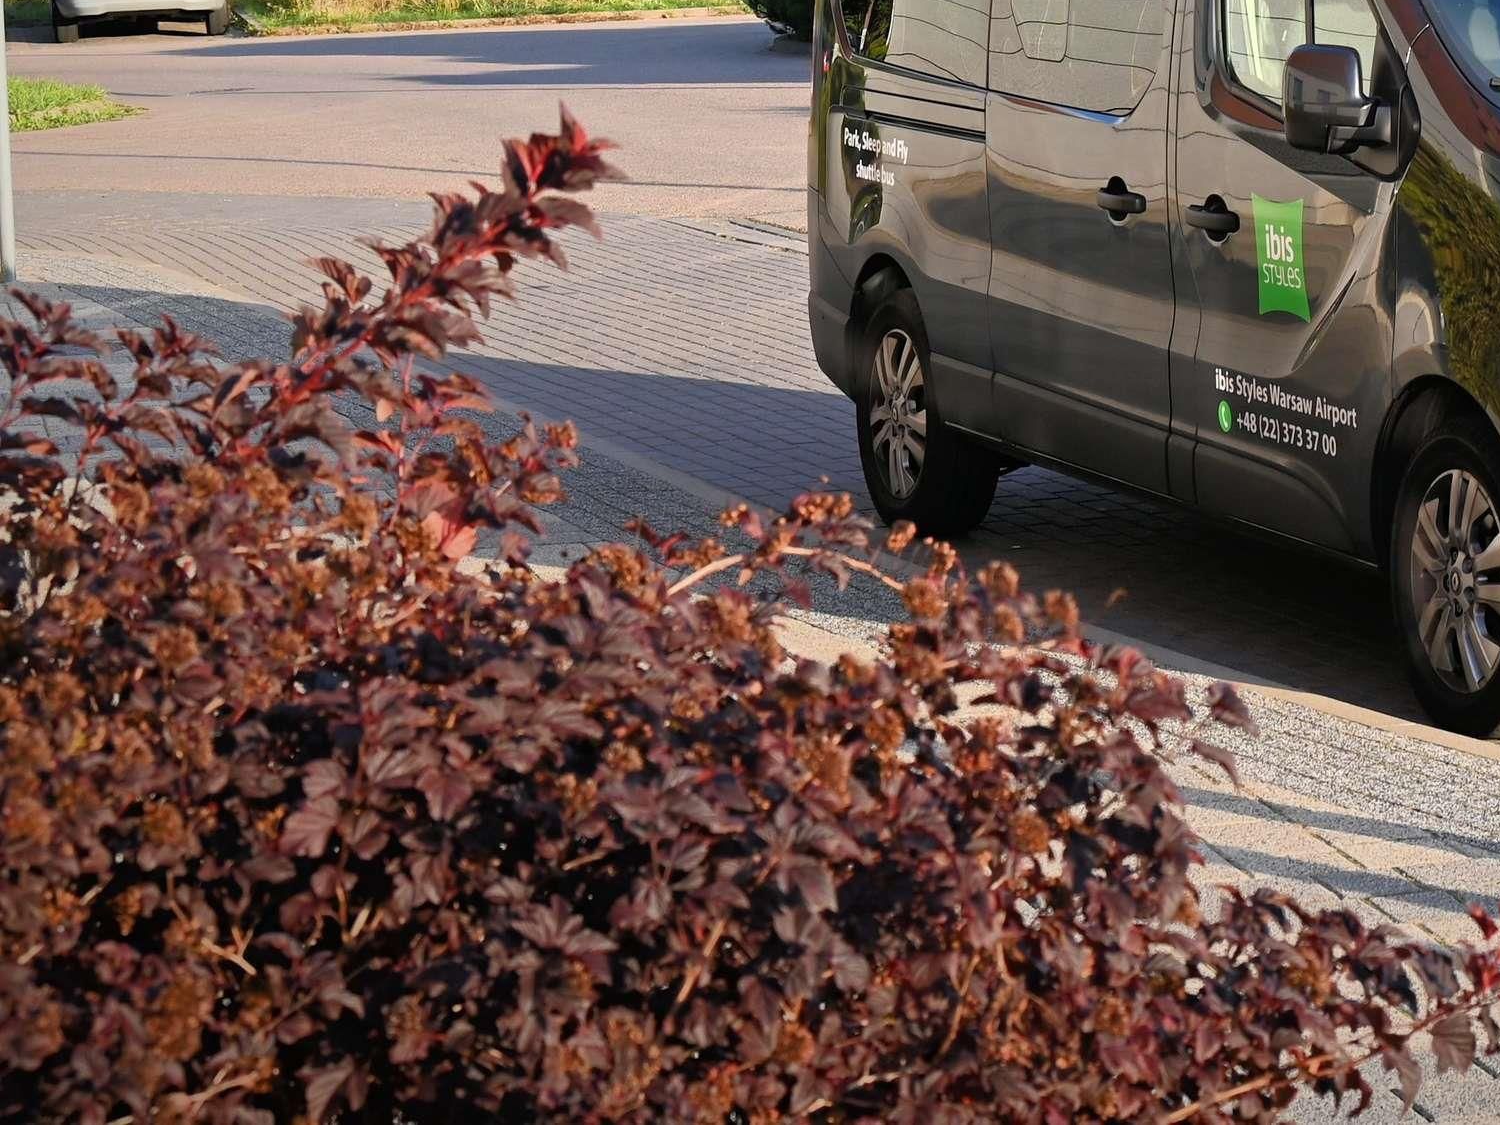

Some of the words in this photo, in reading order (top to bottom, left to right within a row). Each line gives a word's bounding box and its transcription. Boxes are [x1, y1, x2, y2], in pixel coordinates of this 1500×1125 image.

[844, 127, 862, 151] Park,
[862, 131, 881, 157] Sleep
[882, 138, 897, 157] and
[897, 139, 909, 164] Fly
[856, 159, 881, 182] shuttle
[881, 164, 895, 186] bus
[1265, 224, 1295, 264] ibis
[1214, 368, 1235, 394] ibis
[1236, 374, 1269, 404] Styles
[1269, 384, 1313, 417] Warsaw
[1315, 397, 1357, 429] Airport
[1236, 412, 1257, 434] +48
[1259, 415, 1281, 444] (22)
[1282, 425, 1304, 448] 373
[1305, 429, 1322, 452] 37
[1322, 435, 1337, 457] 00
